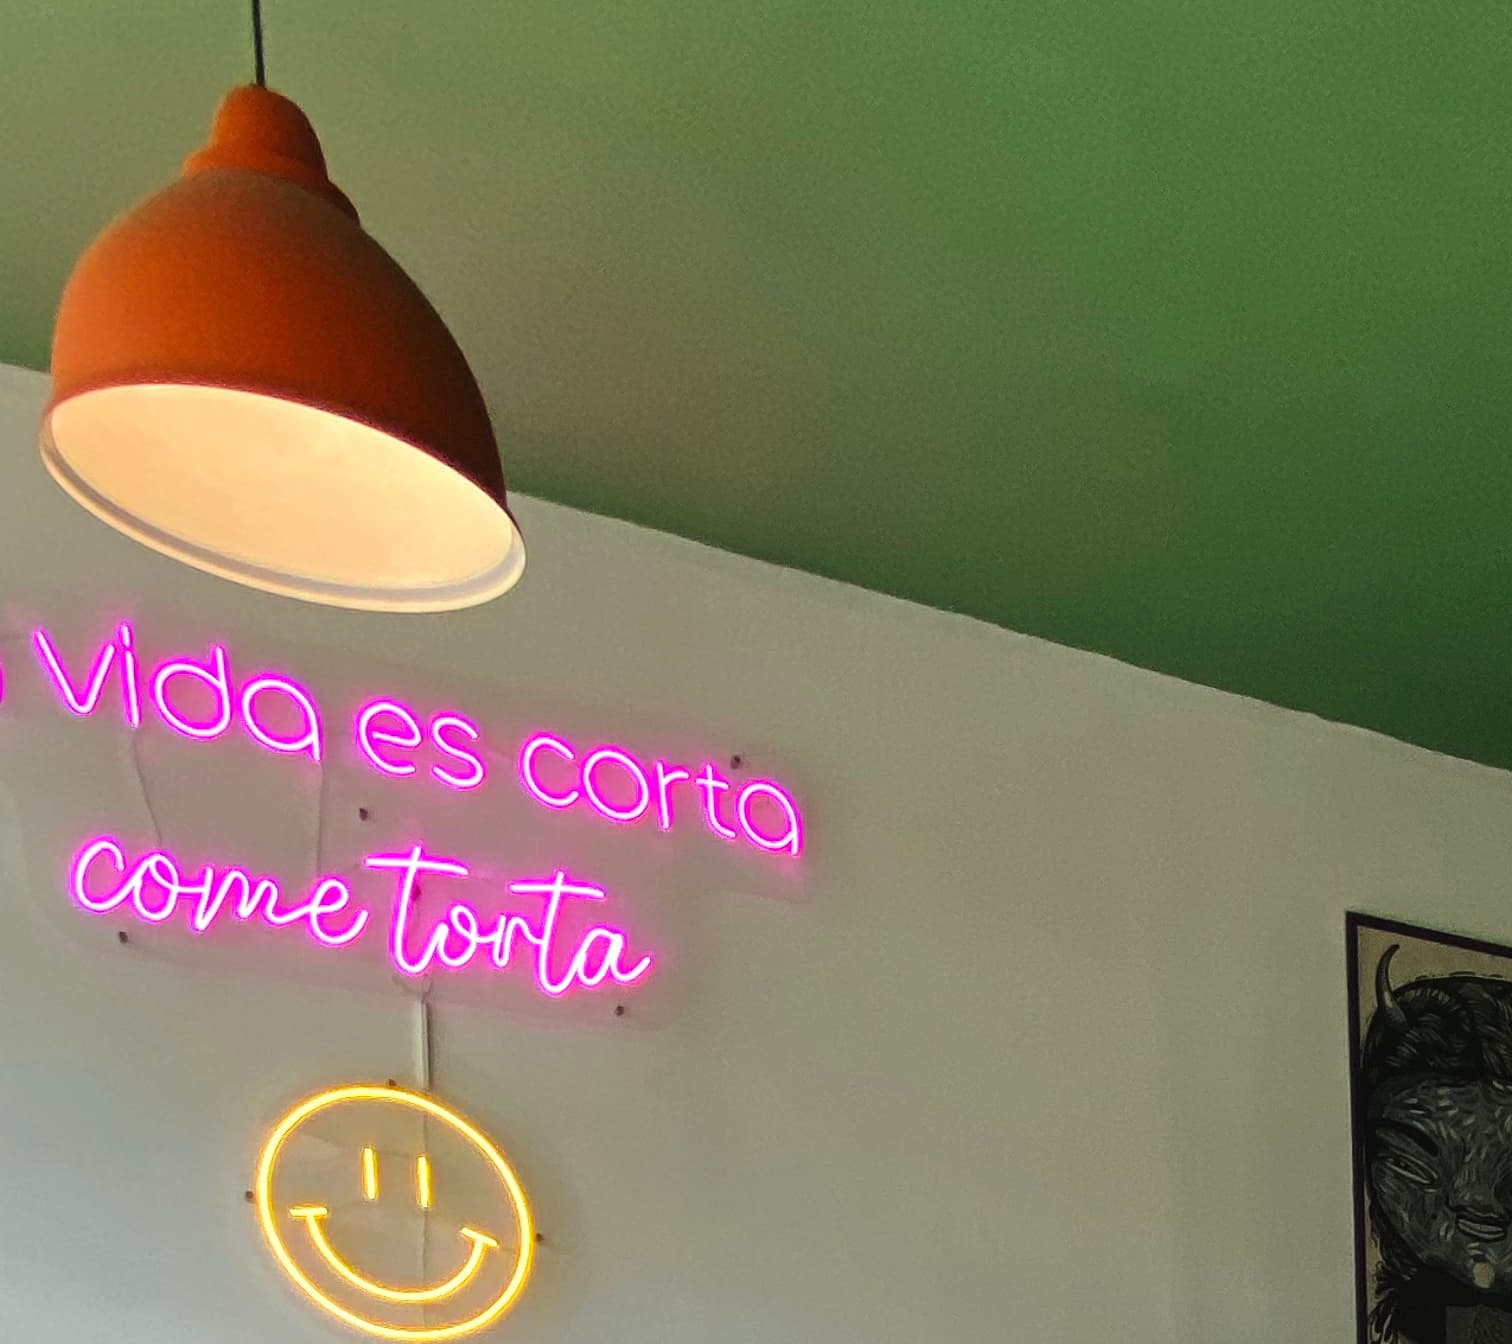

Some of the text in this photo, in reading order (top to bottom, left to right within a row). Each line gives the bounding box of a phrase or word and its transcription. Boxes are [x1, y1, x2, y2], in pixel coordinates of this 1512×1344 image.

[33, 620, 802, 857] vida es corta
[71, 833, 652, 995] come torta
